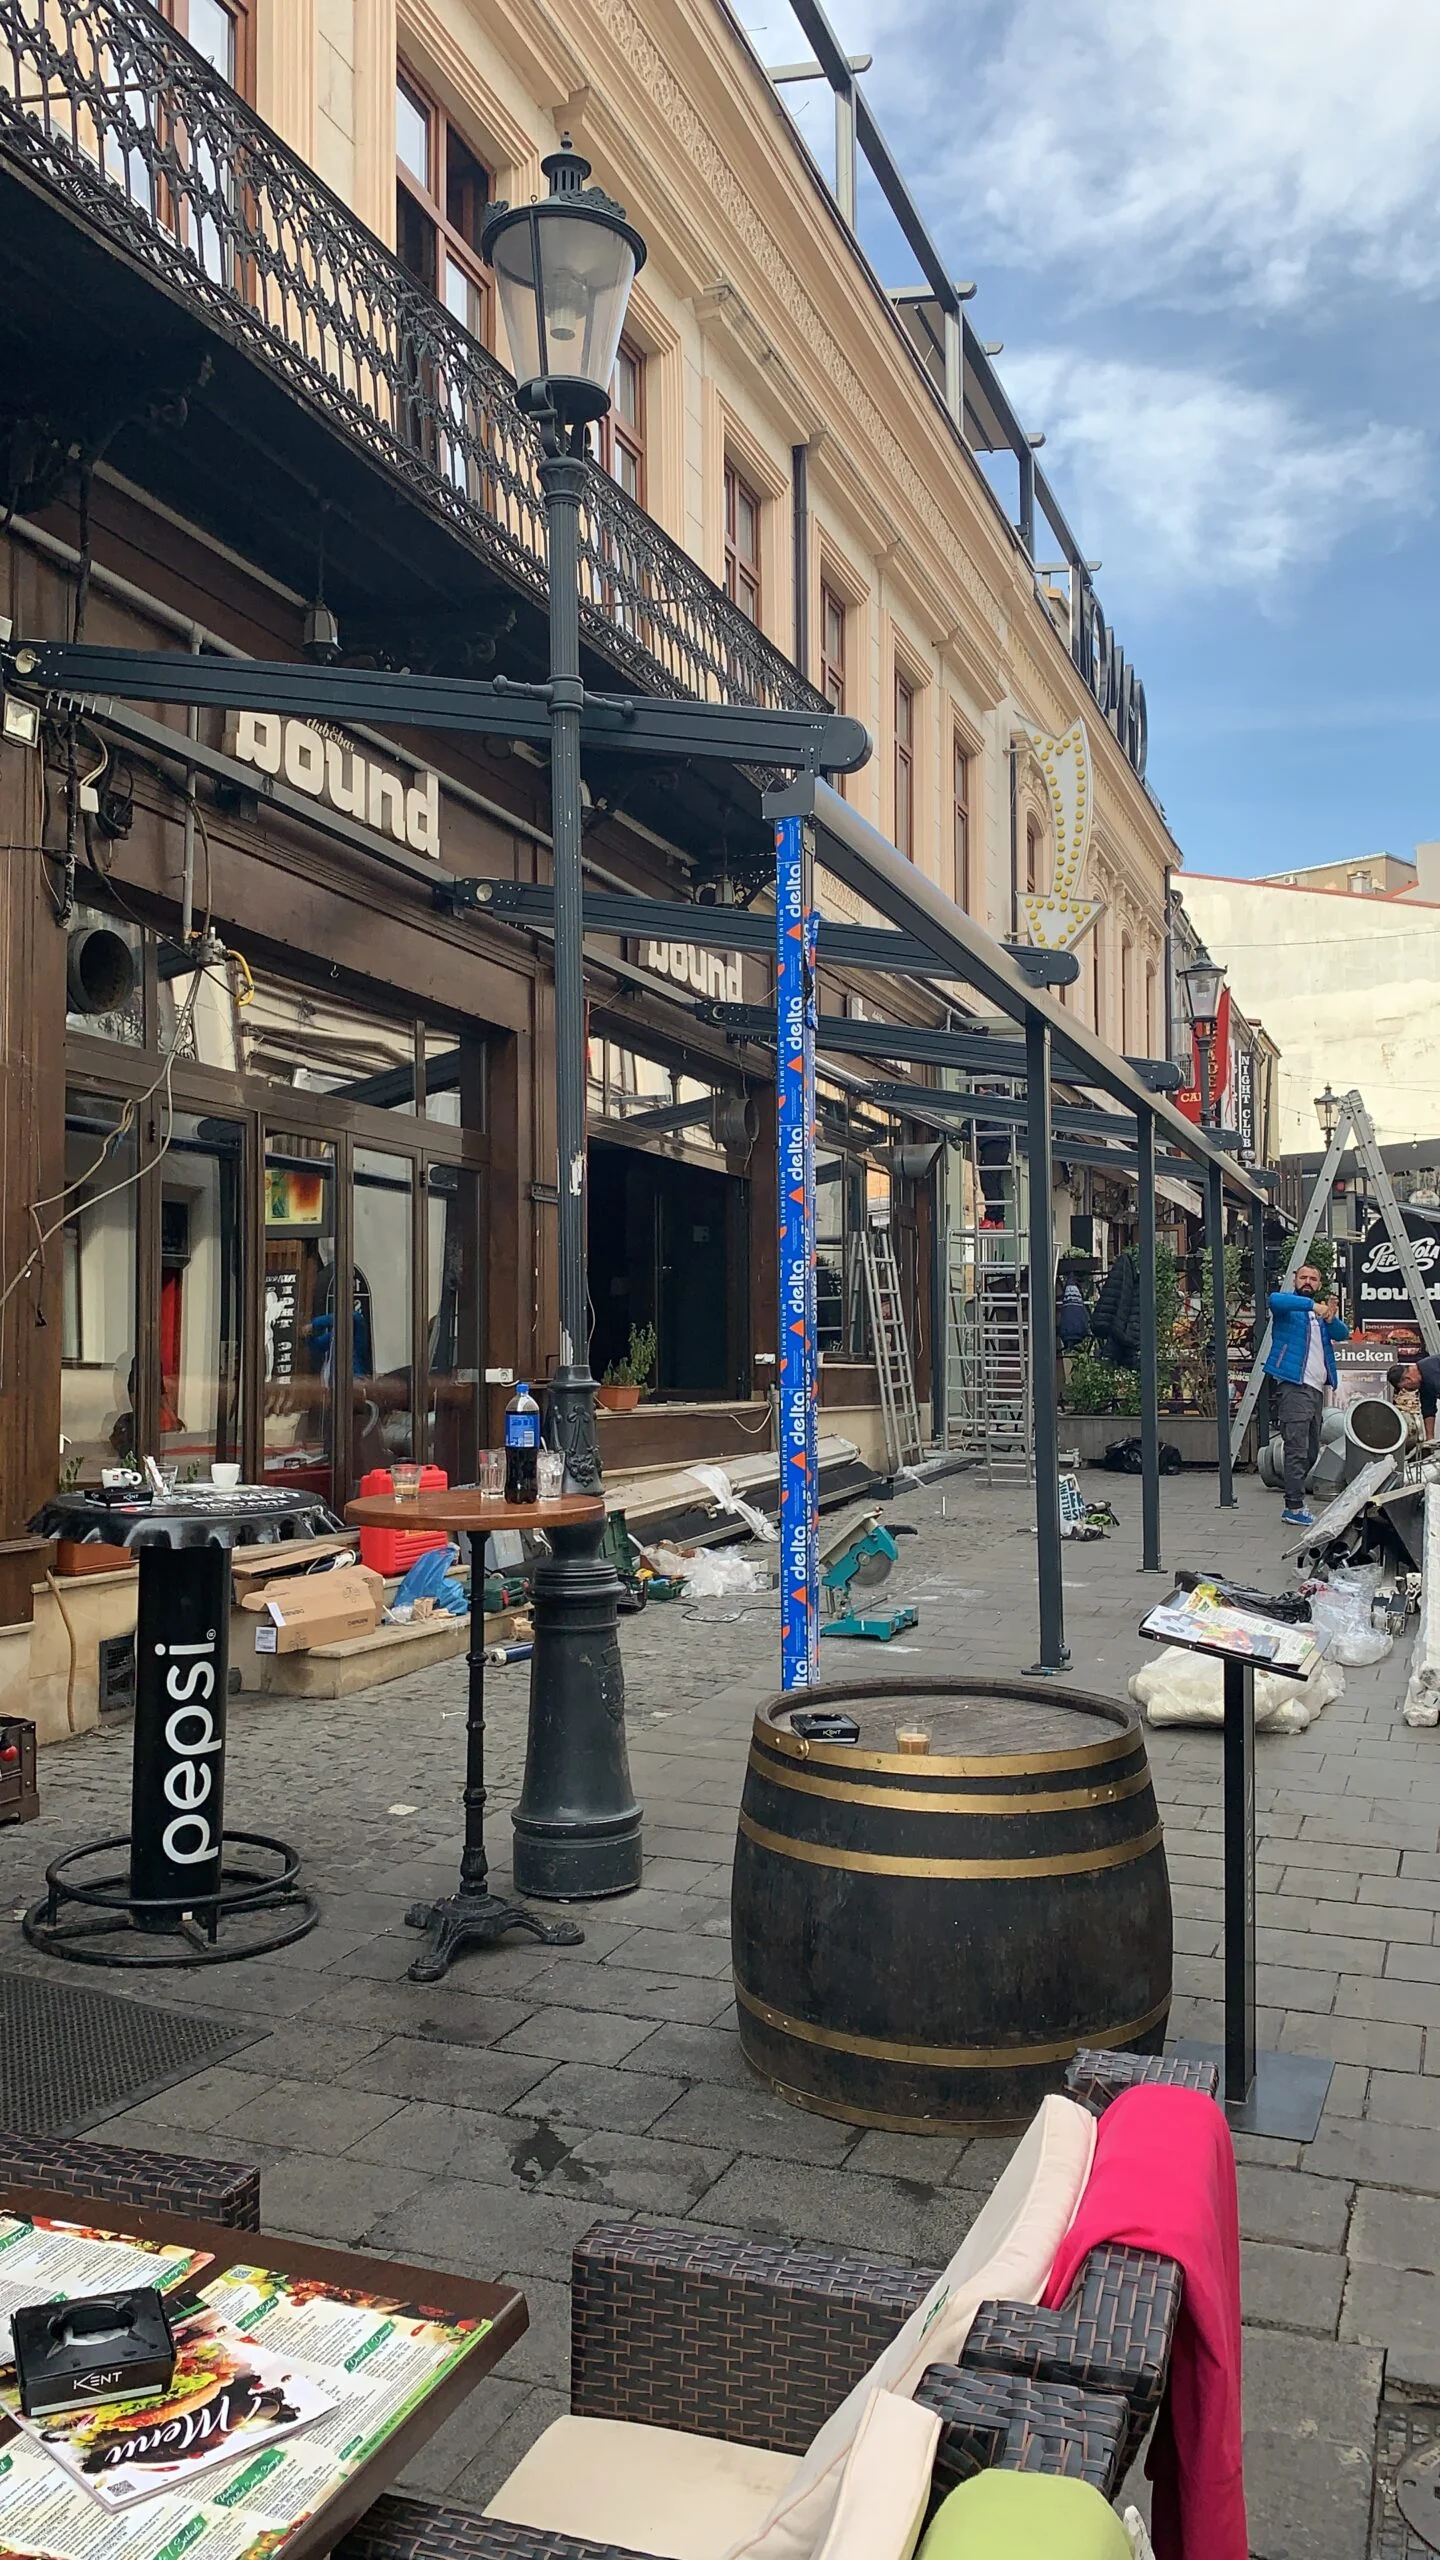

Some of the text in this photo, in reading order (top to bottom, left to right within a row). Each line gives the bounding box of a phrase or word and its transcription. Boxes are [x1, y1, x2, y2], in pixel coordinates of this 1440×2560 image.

[785, 863, 801, 918] delta
[786, 997, 802, 1050] delta
[1241, 1056, 1251, 1148] NIGHT CLUB
[787, 1126, 804, 1181] delta
[787, 1260, 805, 1315] delta
[1361, 1283, 1440, 1300] boud
[1334, 1348, 1394, 1362] eineken
[789, 1391, 806, 1446] delta
[789, 1525, 807, 1580] delta
[792, 1659, 808, 1689] lta
[154, 1642, 222, 1864] pepsi
[73, 2371, 122, 2393] KENT
[104, 2395, 262, 2464] Menu
